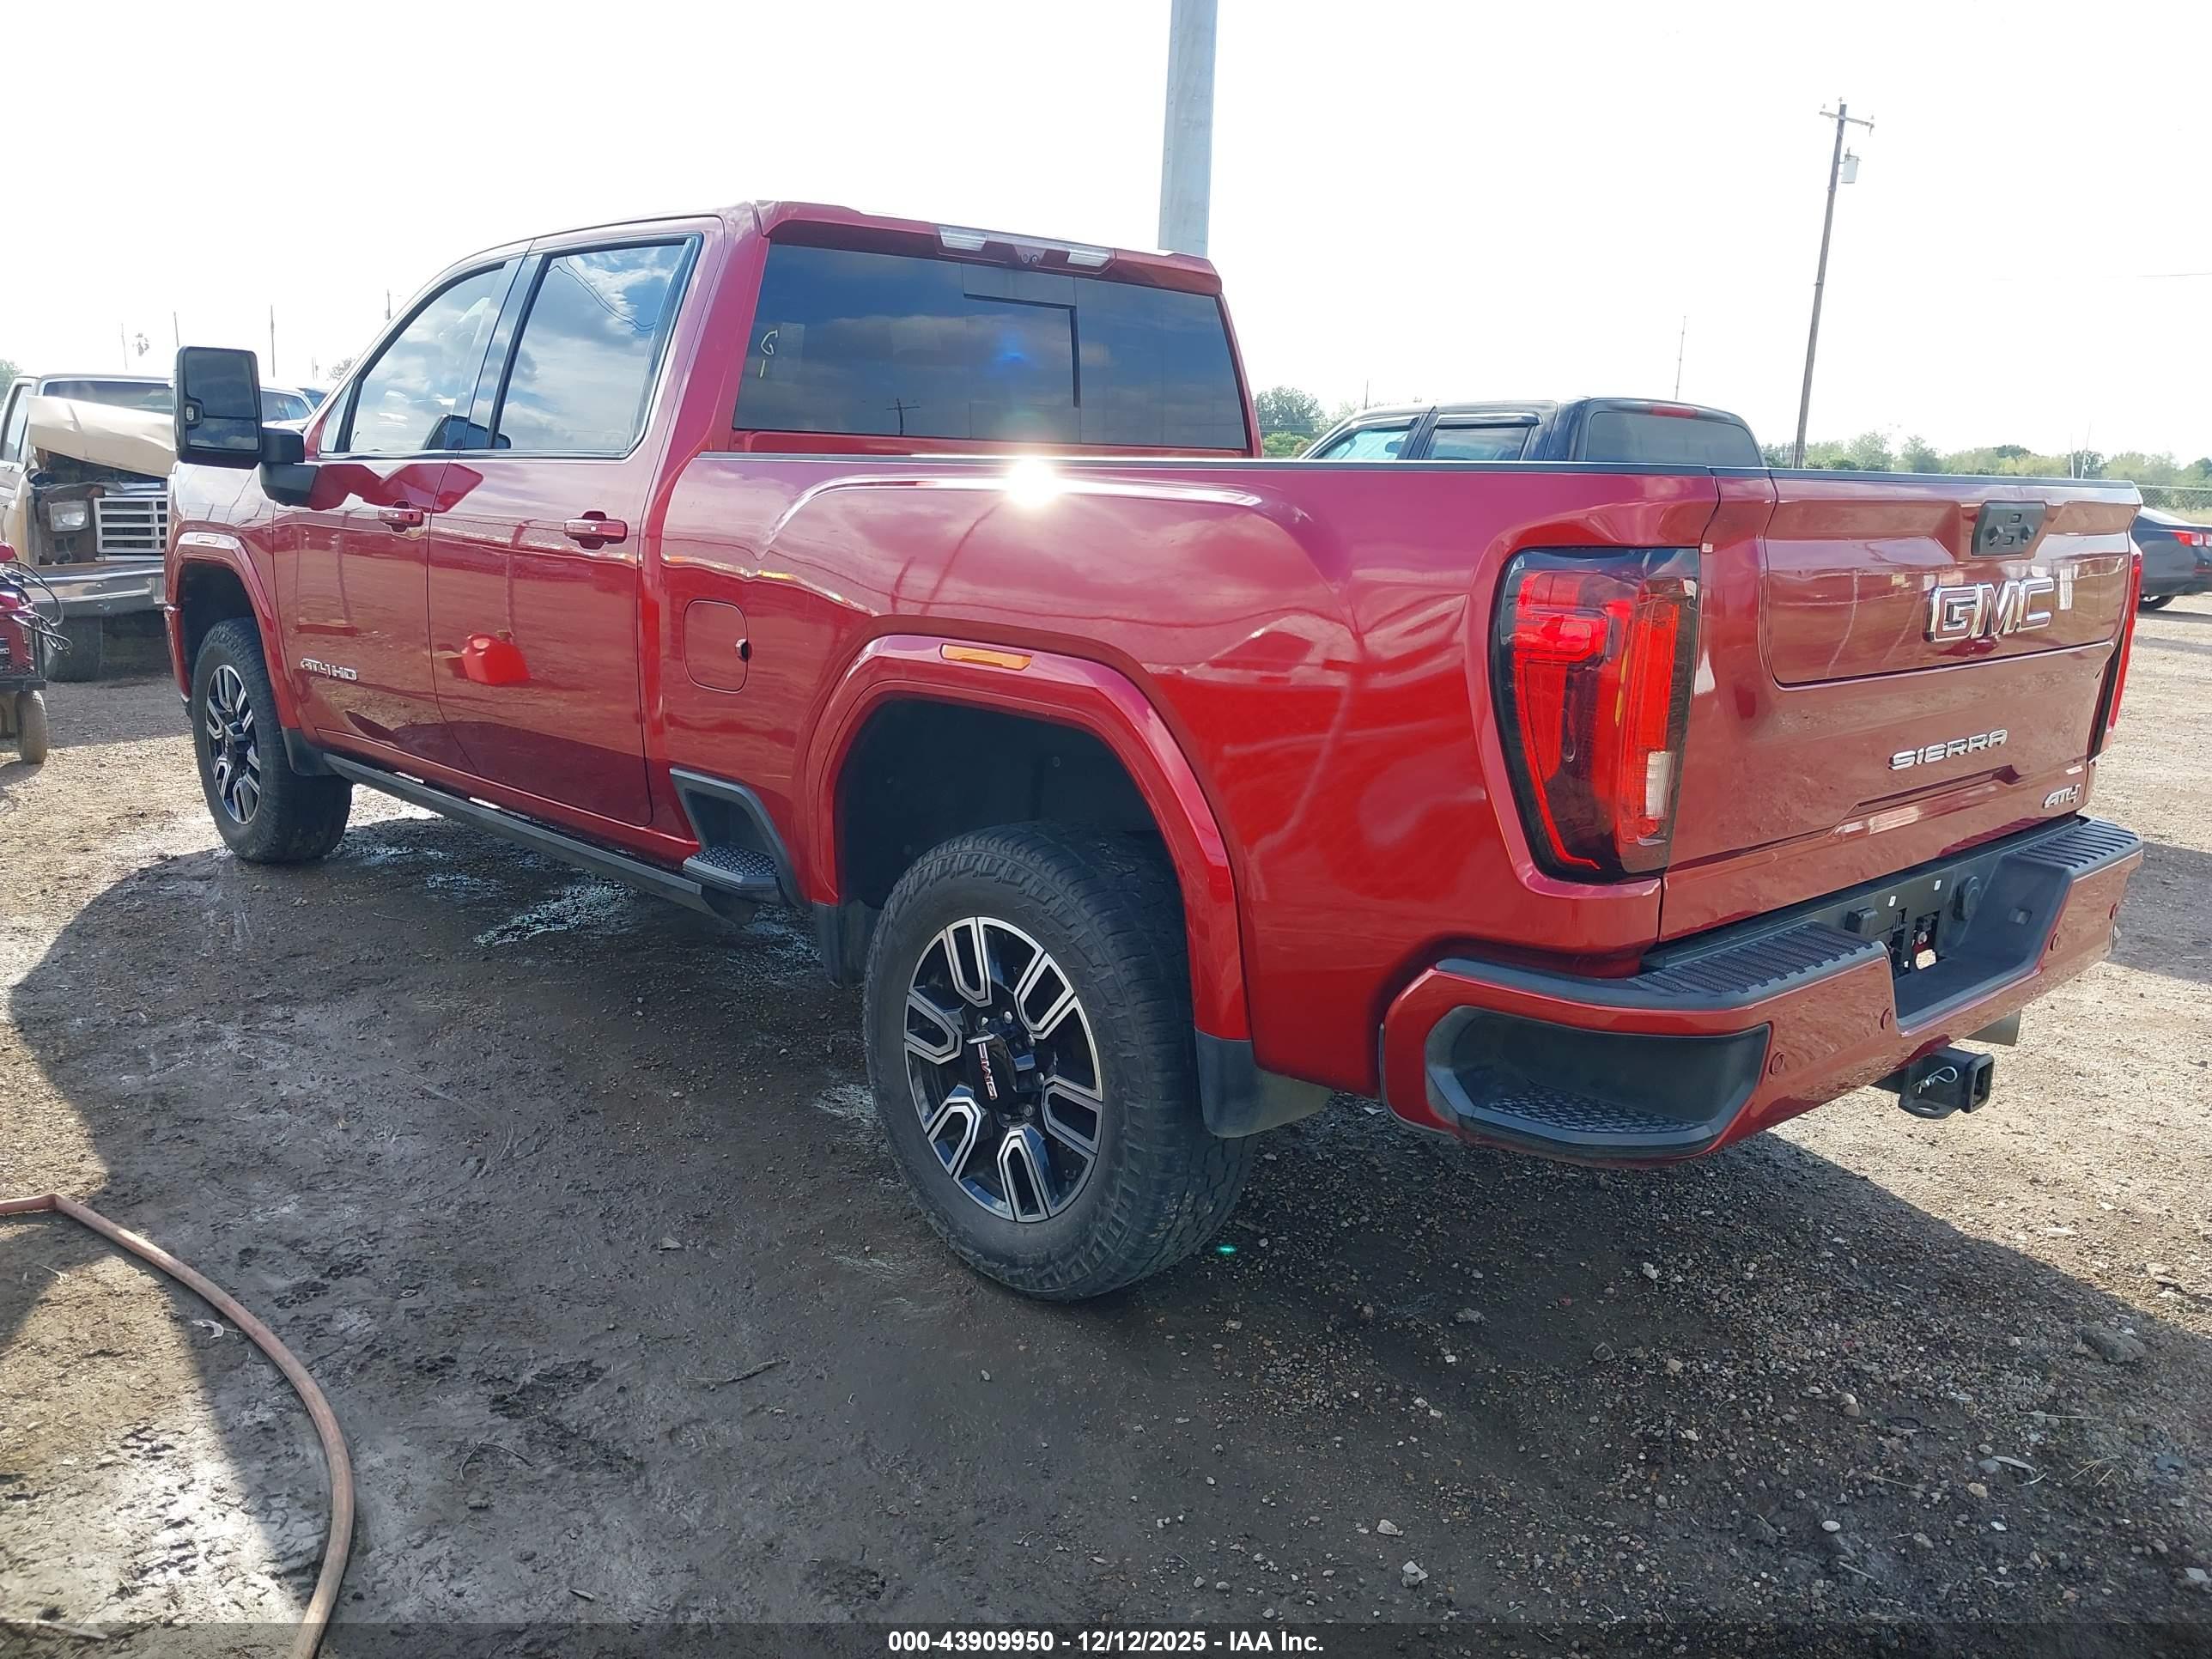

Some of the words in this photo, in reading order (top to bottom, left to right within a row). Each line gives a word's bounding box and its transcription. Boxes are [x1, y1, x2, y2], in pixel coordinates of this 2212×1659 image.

[1923, 576, 2055, 643] GMC
[1889, 728, 2008, 771] SIERRA
[2043, 783, 2081, 809] AT4
[977, 1042, 999, 1101] GMC
